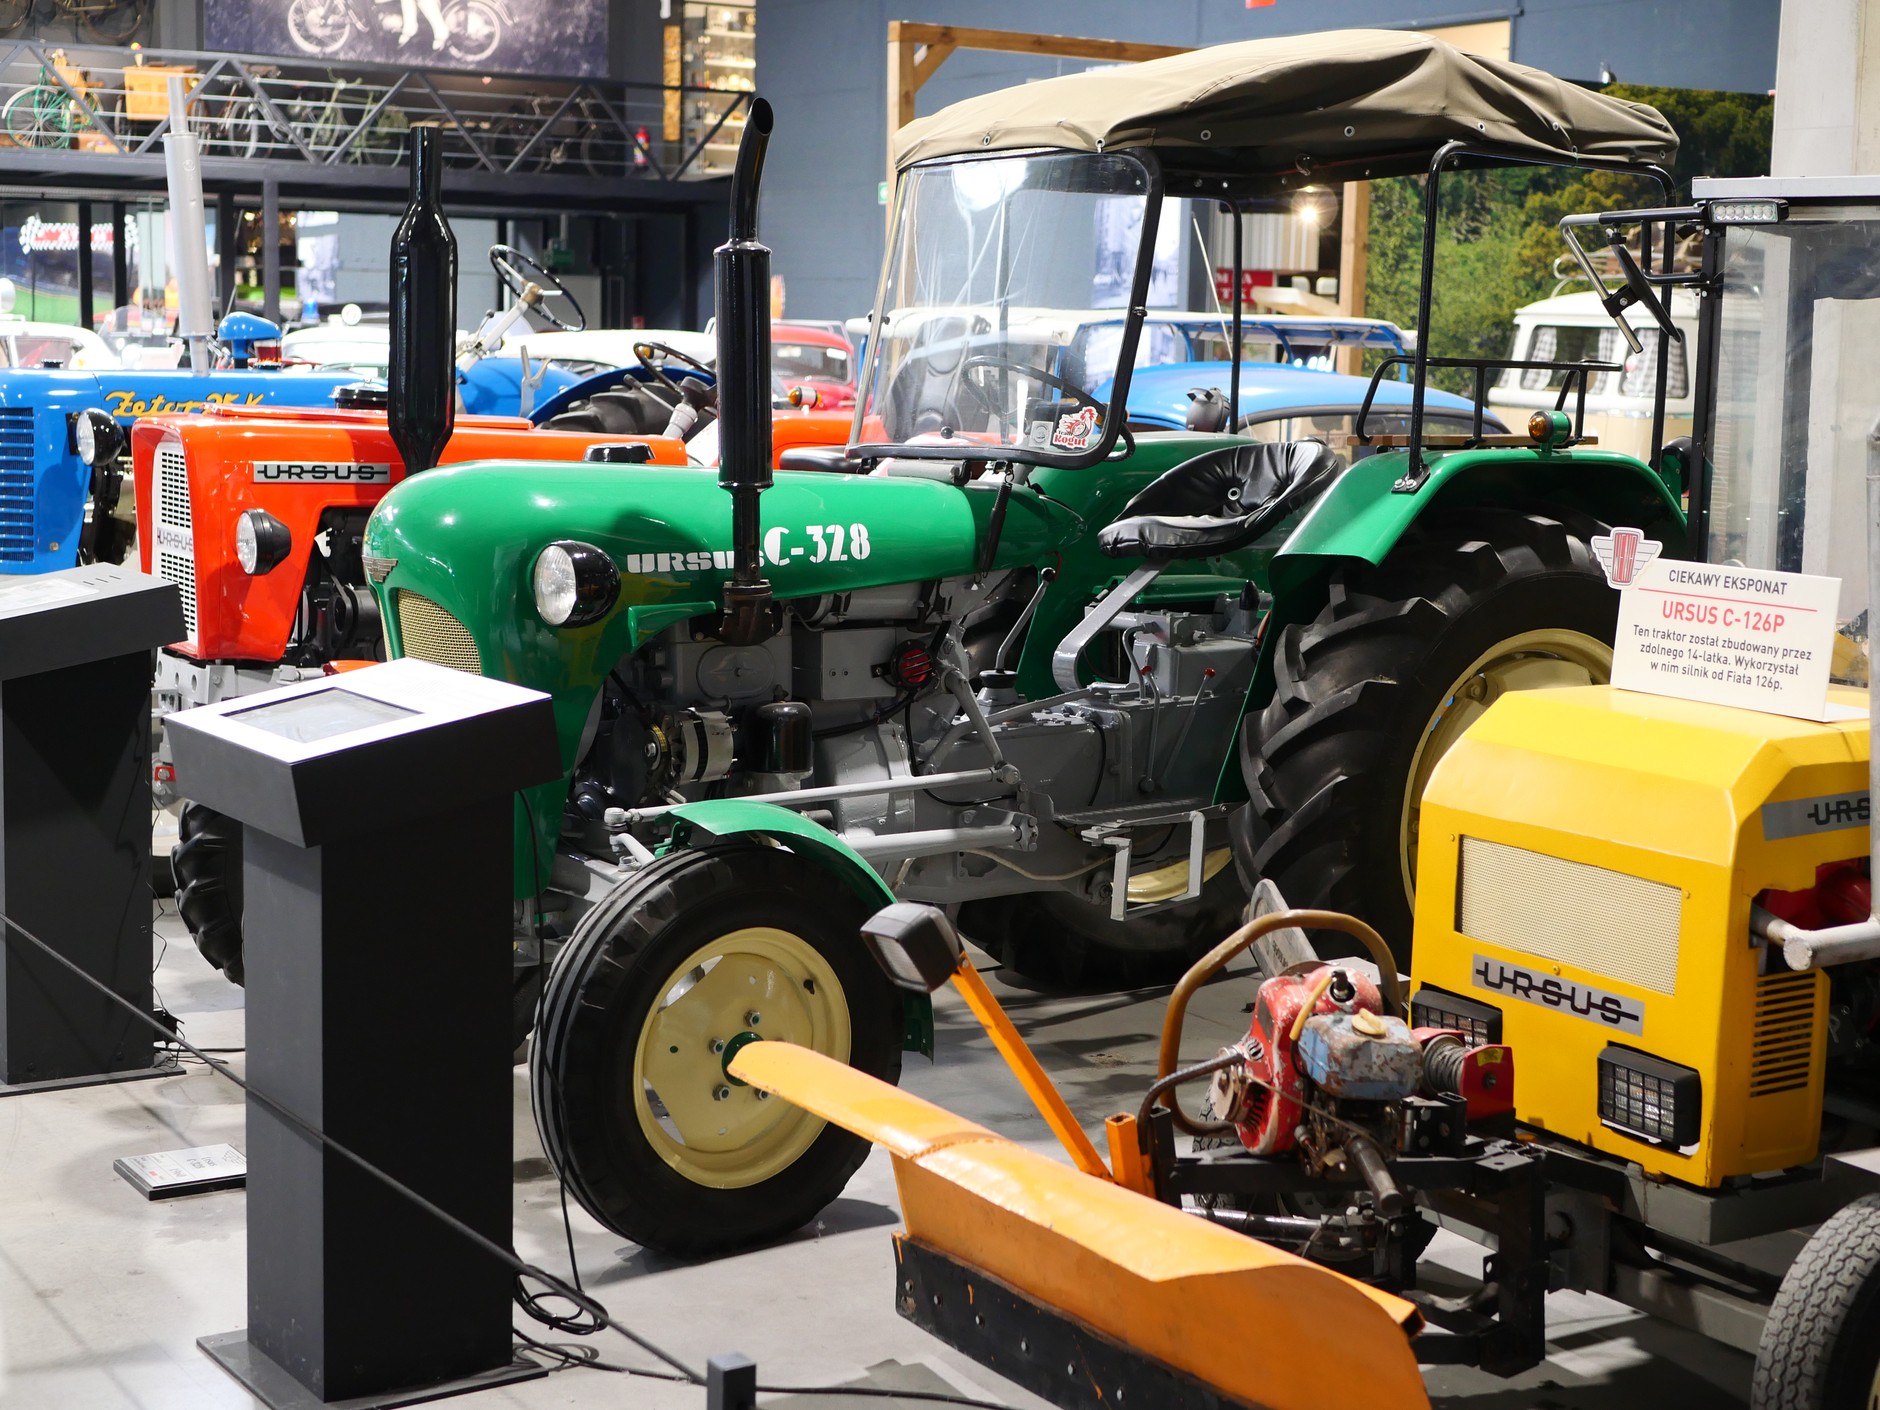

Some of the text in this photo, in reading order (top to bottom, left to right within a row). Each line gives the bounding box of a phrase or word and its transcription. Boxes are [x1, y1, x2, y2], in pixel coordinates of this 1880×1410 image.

[105, 391, 203, 417] Zetor
[1054, 434, 1087, 446] Kogut
[257, 464, 388, 480] URSUS
[626, 523, 871, 574] URSU C-328
[1668, 569, 1788, 596] CIEKAWY EKSPONAT
[1662, 600, 1785, 634] URSUS C-126P
[1633, 624, 1812, 661] Ten traktor został zbudowany przez
[1640, 643, 1799, 676] zdolnego 14-latka. Wykorzystał
[1650, 661, 1783, 692] w nim silnik od Fiata 126p.
[1807, 798, 1870, 825] URS
[1476, 962, 1639, 1025] URSUS
